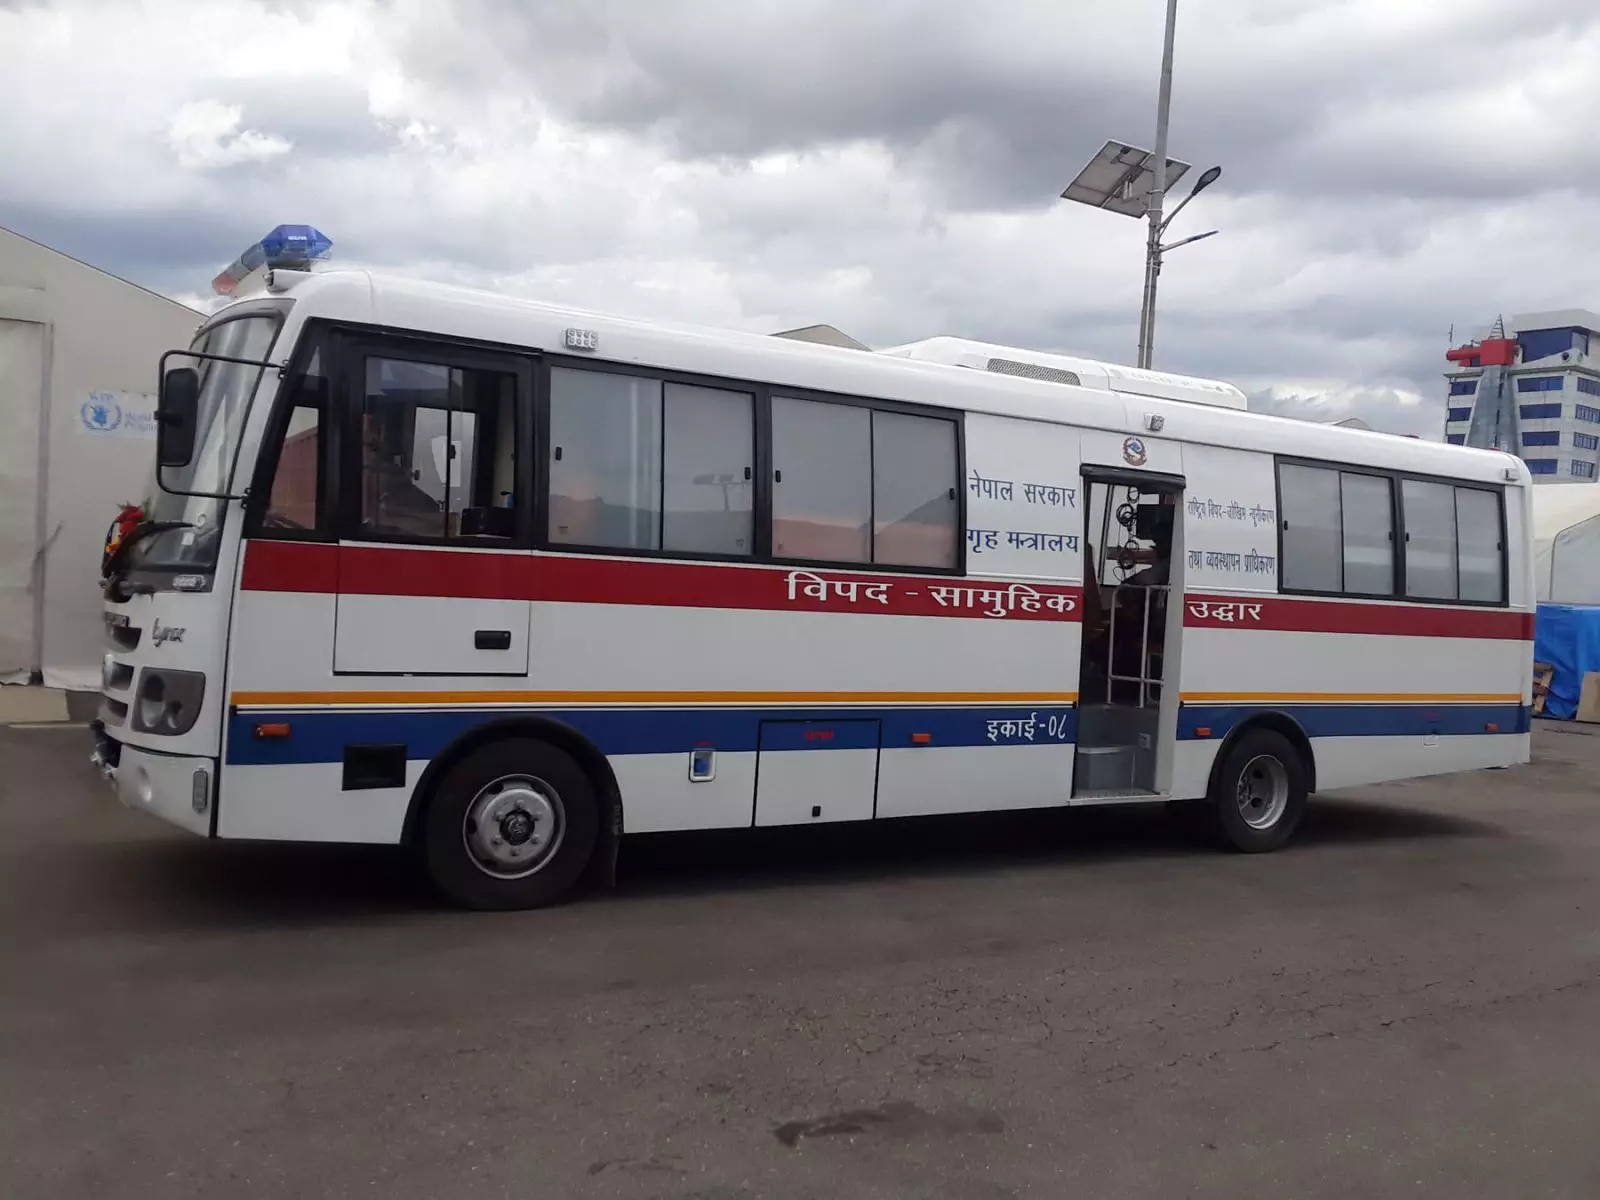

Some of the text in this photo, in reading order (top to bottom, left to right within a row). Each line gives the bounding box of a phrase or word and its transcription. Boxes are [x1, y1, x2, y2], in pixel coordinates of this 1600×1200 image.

[968, 469, 1076, 508] नेपाल सरकार
[966, 529, 1079, 553] गृह मन्त्रालय
[1188, 548, 1275, 575] तथा व्यवस्थापन प्राधिकरण
[784, 571, 894, 604] विपद
[927, 583, 1078, 617] सामुहिक
[1186, 601, 1263, 622] उद्धार
[986, 712, 1067, 742] इकाई-०८
